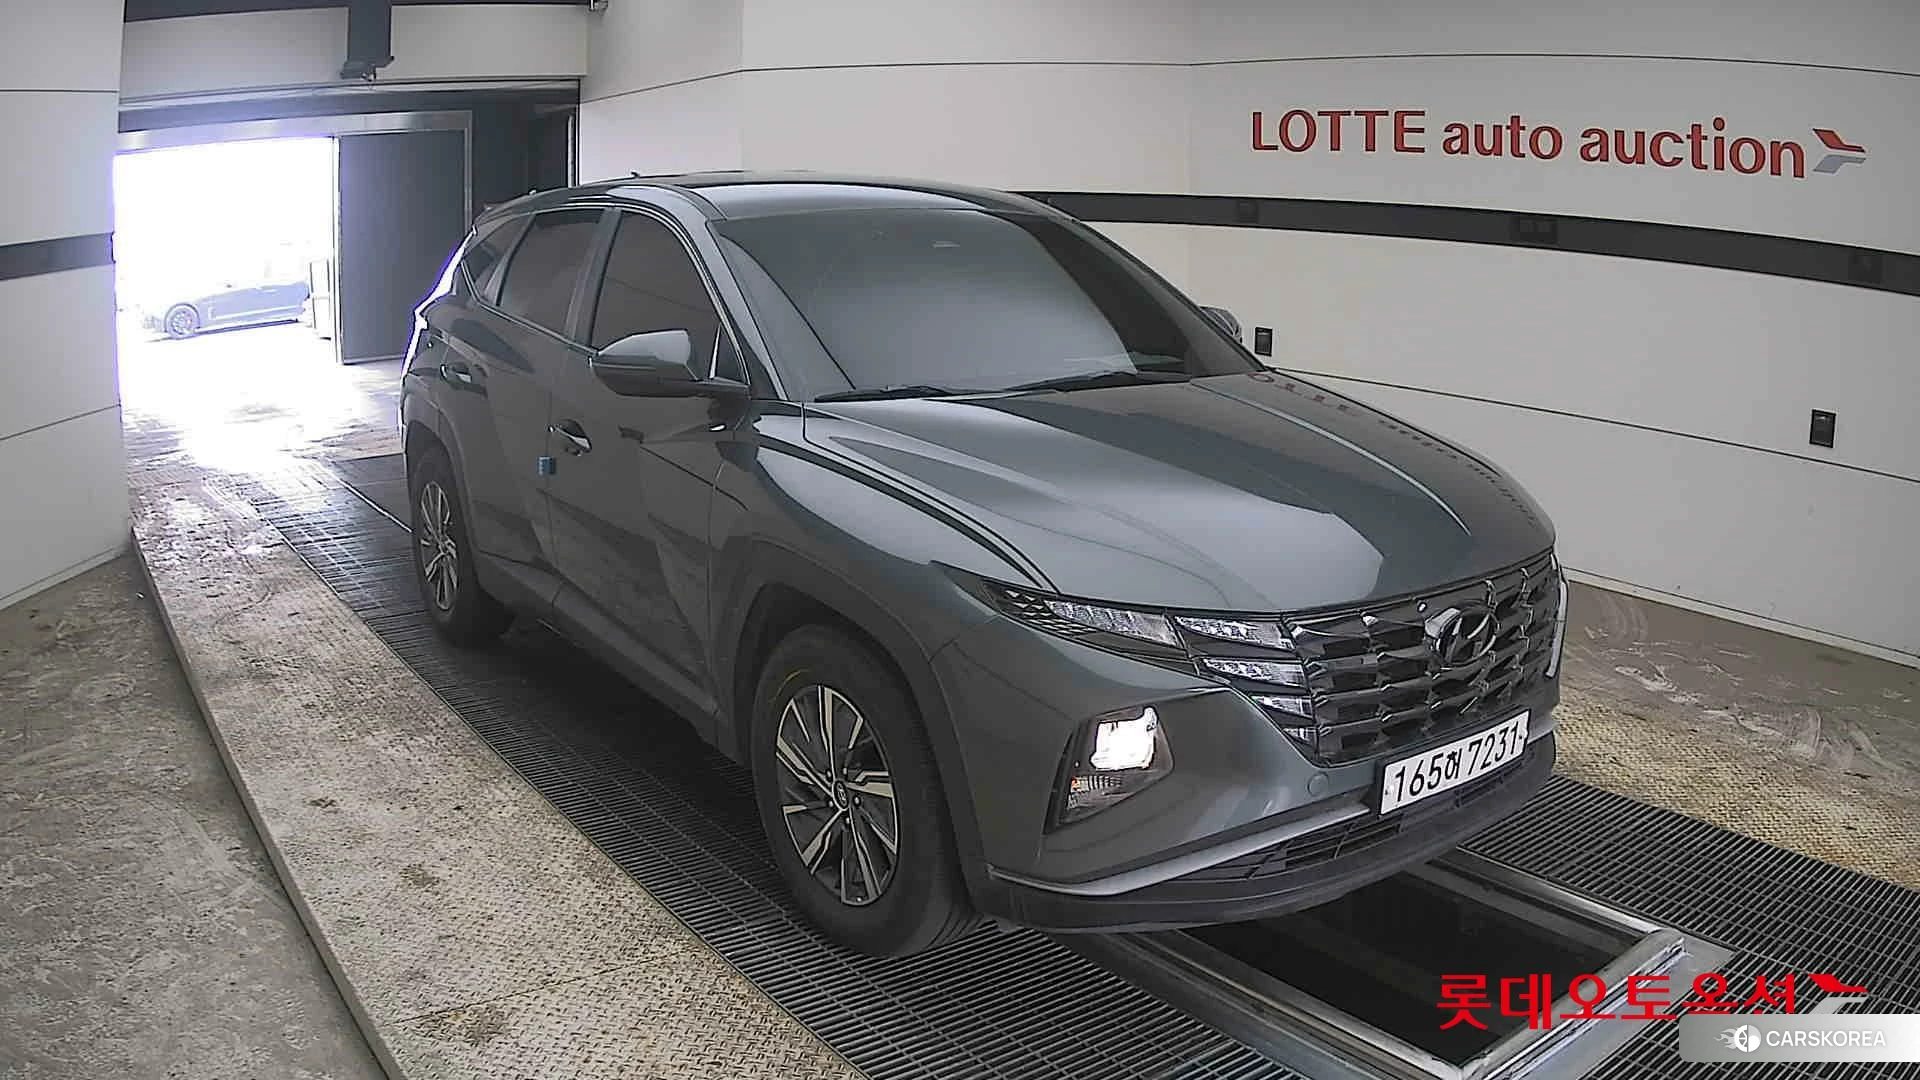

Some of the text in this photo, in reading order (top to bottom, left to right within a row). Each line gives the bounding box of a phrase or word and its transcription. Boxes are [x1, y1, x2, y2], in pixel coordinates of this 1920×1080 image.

[1252, 110, 1805, 178] LOTTE auto auction
[1395, 721, 1519, 802] 165허 7231
